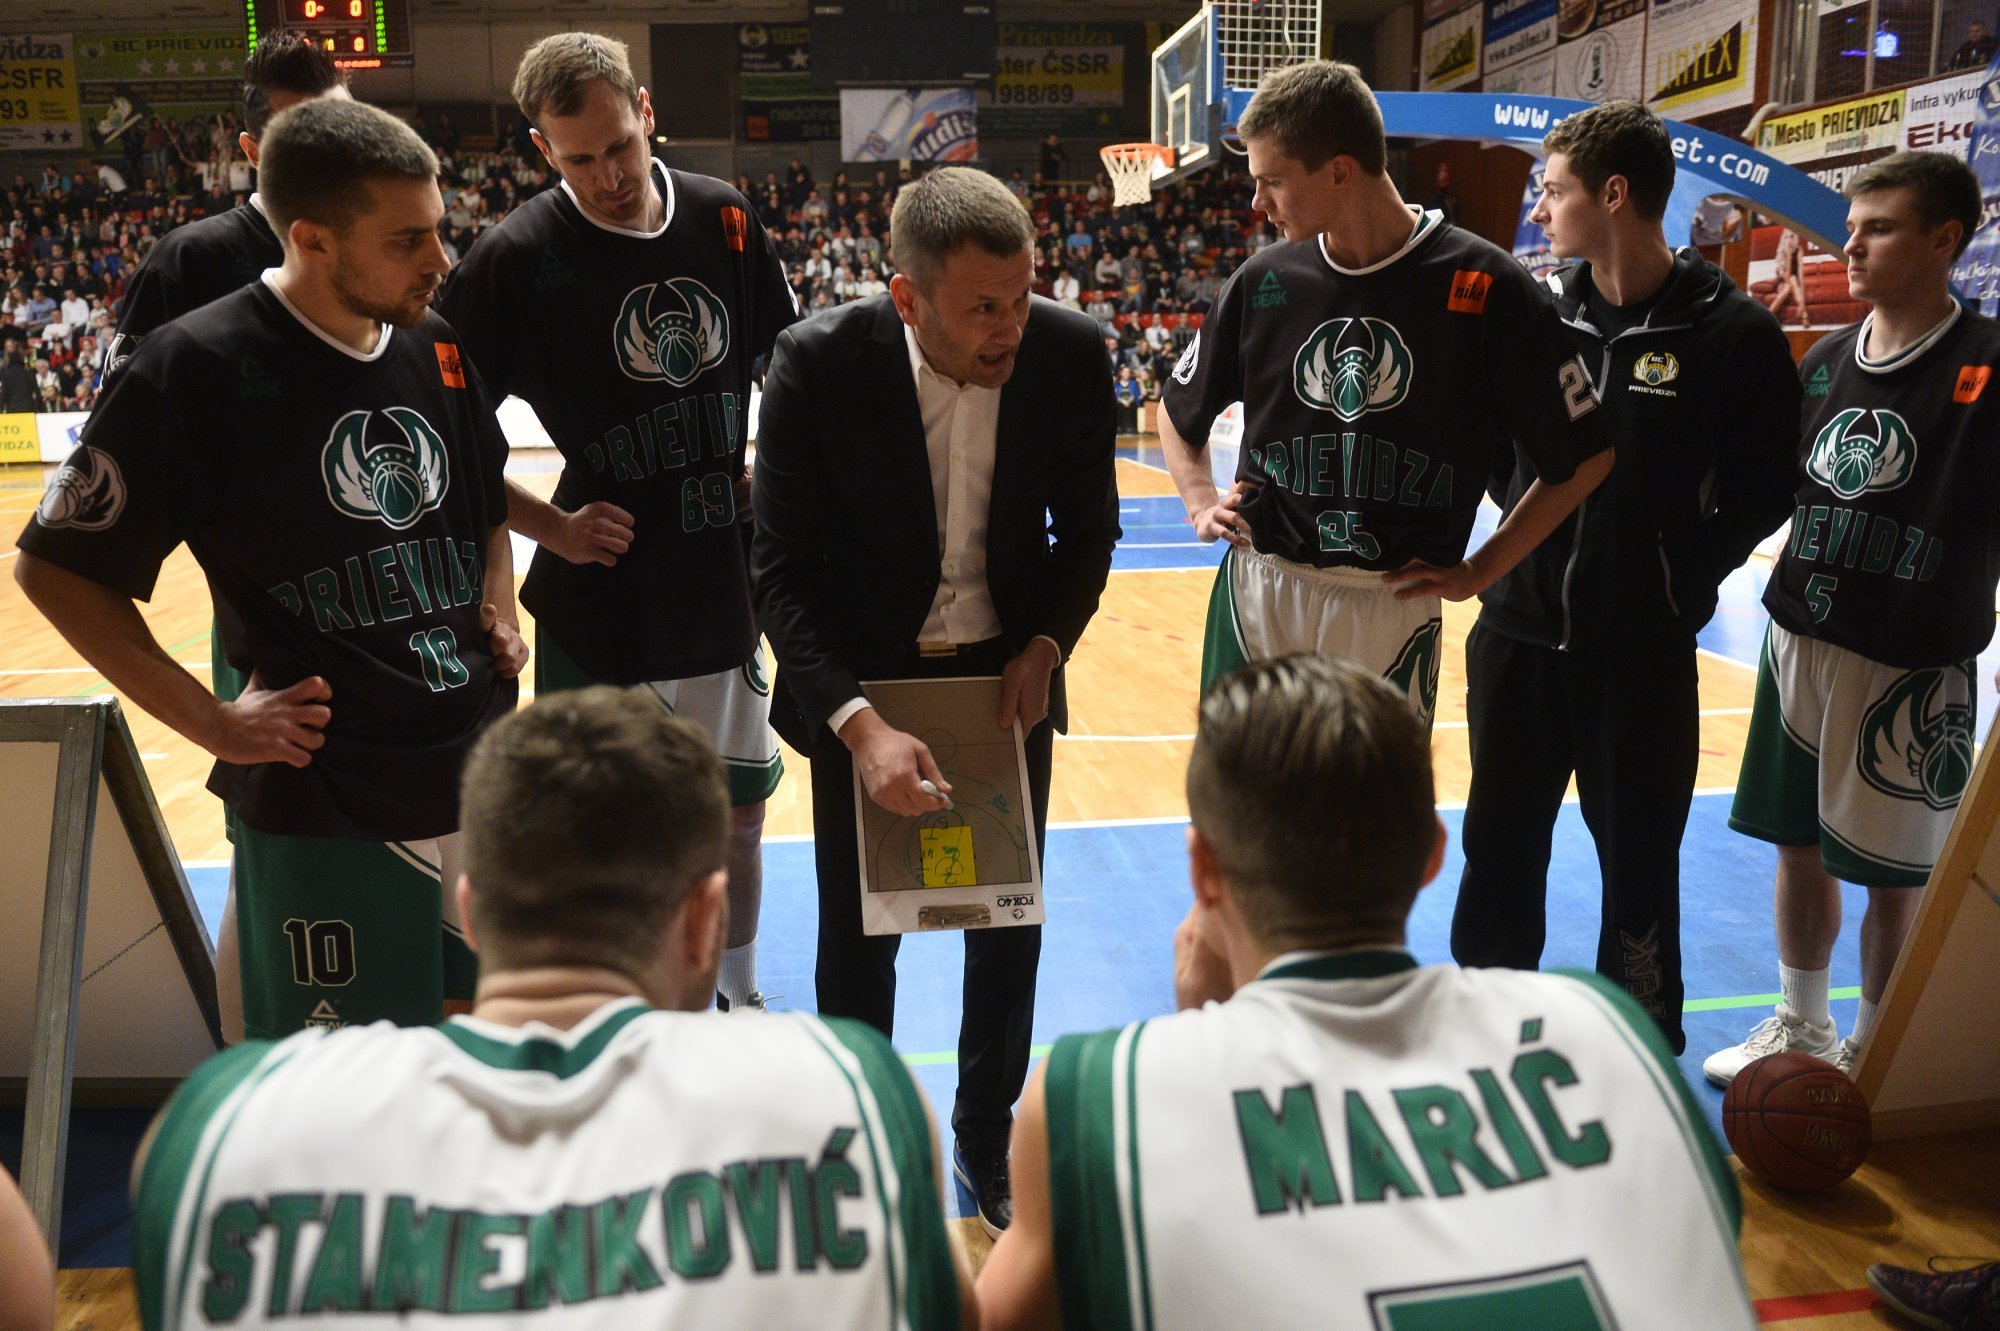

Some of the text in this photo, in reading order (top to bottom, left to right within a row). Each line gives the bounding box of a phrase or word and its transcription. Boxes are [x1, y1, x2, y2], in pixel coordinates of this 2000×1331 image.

[1775, 98, 1899, 147] Mesto PRIEVIDZA
[1911, 94, 1938, 112] Infra
[1251, 290, 1288, 310] PEAK
[1628, 385, 1678, 398] PRIEVIDZA
[682, 472, 736, 534] 69
[1316, 510, 1381, 560] 25
[1805, 572, 1839, 624] 5
[409, 626, 470, 692] 10
[283, 918, 357, 987] 10
[1232, 1016, 1613, 1219] MARIĆ
[202, 1126, 869, 1323] STAMENKOVIĆ
